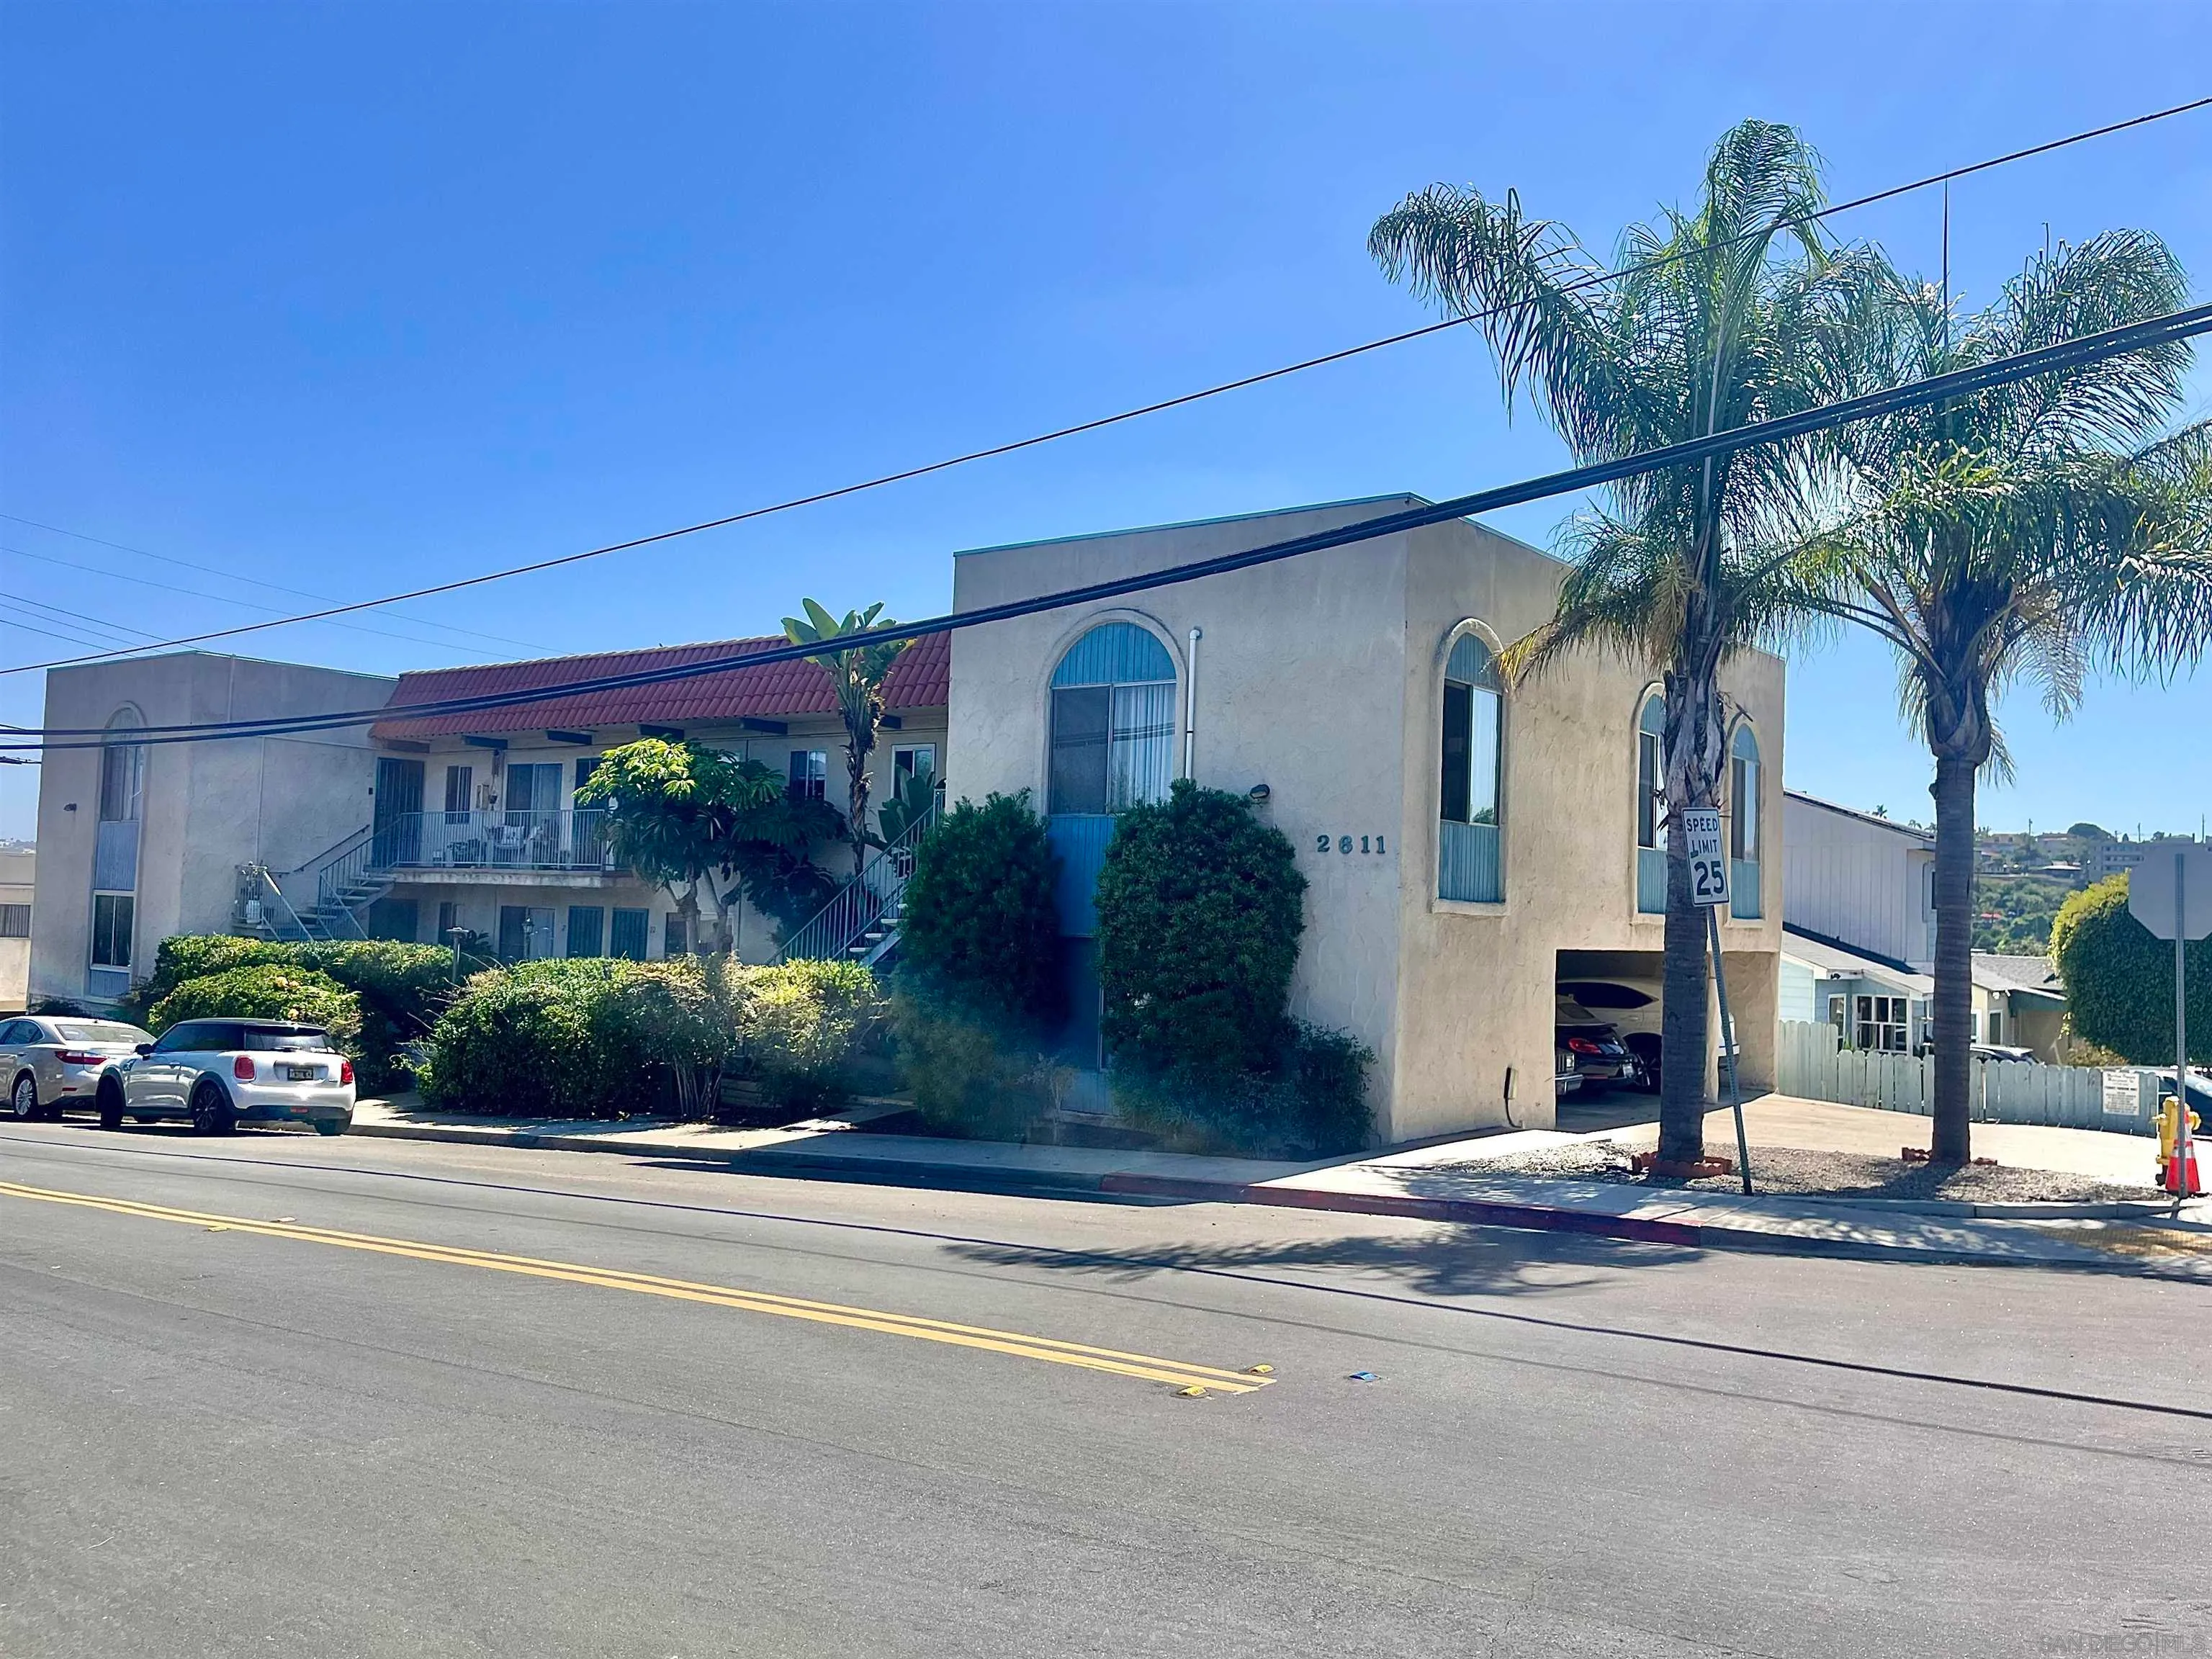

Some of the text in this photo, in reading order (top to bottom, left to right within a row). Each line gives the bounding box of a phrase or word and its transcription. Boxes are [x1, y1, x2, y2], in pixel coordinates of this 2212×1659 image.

[1686, 818, 1718, 832] SPEED
[1317, 835, 1385, 854] 2611
[1690, 840, 1717, 858] LIMIT
[1694, 860, 1725, 896] 25
